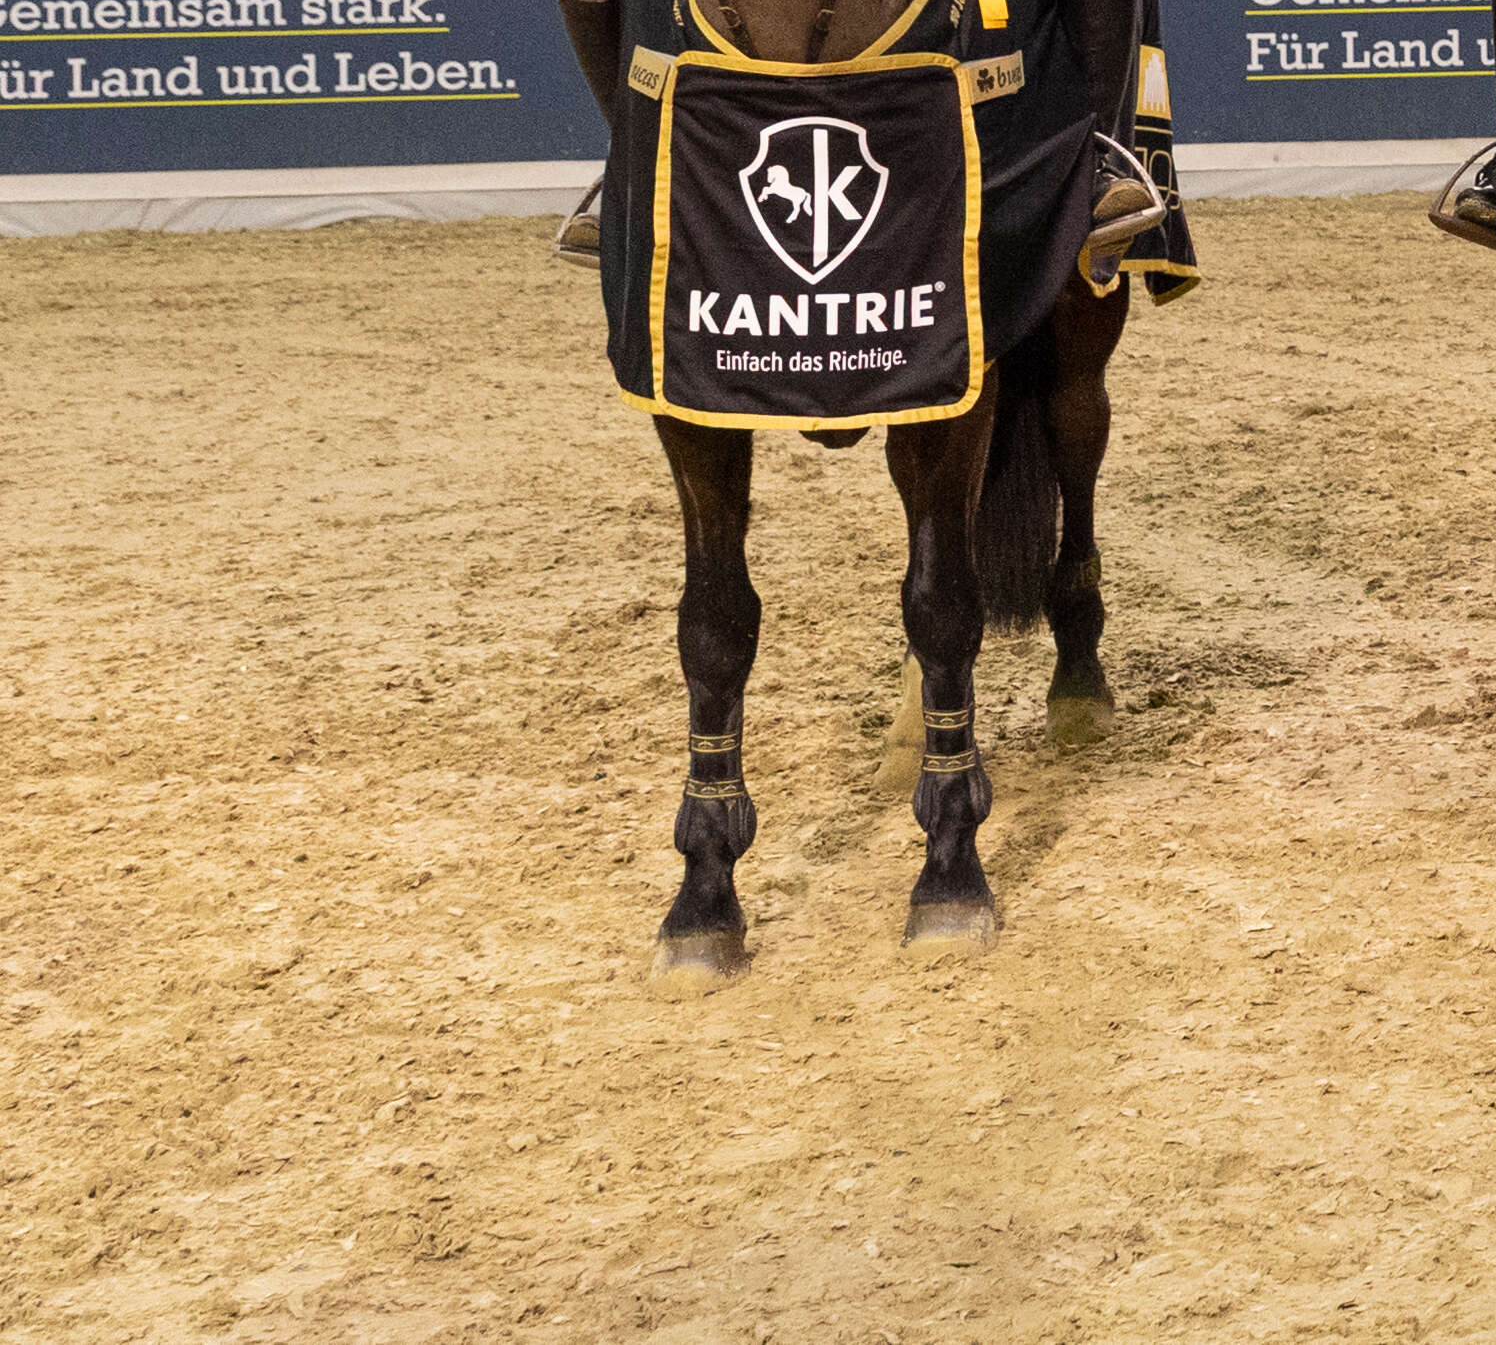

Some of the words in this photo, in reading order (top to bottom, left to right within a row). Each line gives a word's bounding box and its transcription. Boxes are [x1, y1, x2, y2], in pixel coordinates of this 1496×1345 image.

[1246, 32, 1330, 72] Für
[1340, 29, 1464, 70] Land
[0, 59, 54, 100] ür
[66, 55, 204, 99] Land
[216, 52, 320, 96] und
[334, 50, 517, 94] Leben.
[716, 349, 783, 373] Einfach
[788, 351, 823, 373] das
[828, 347, 908, 372] Richtige.
